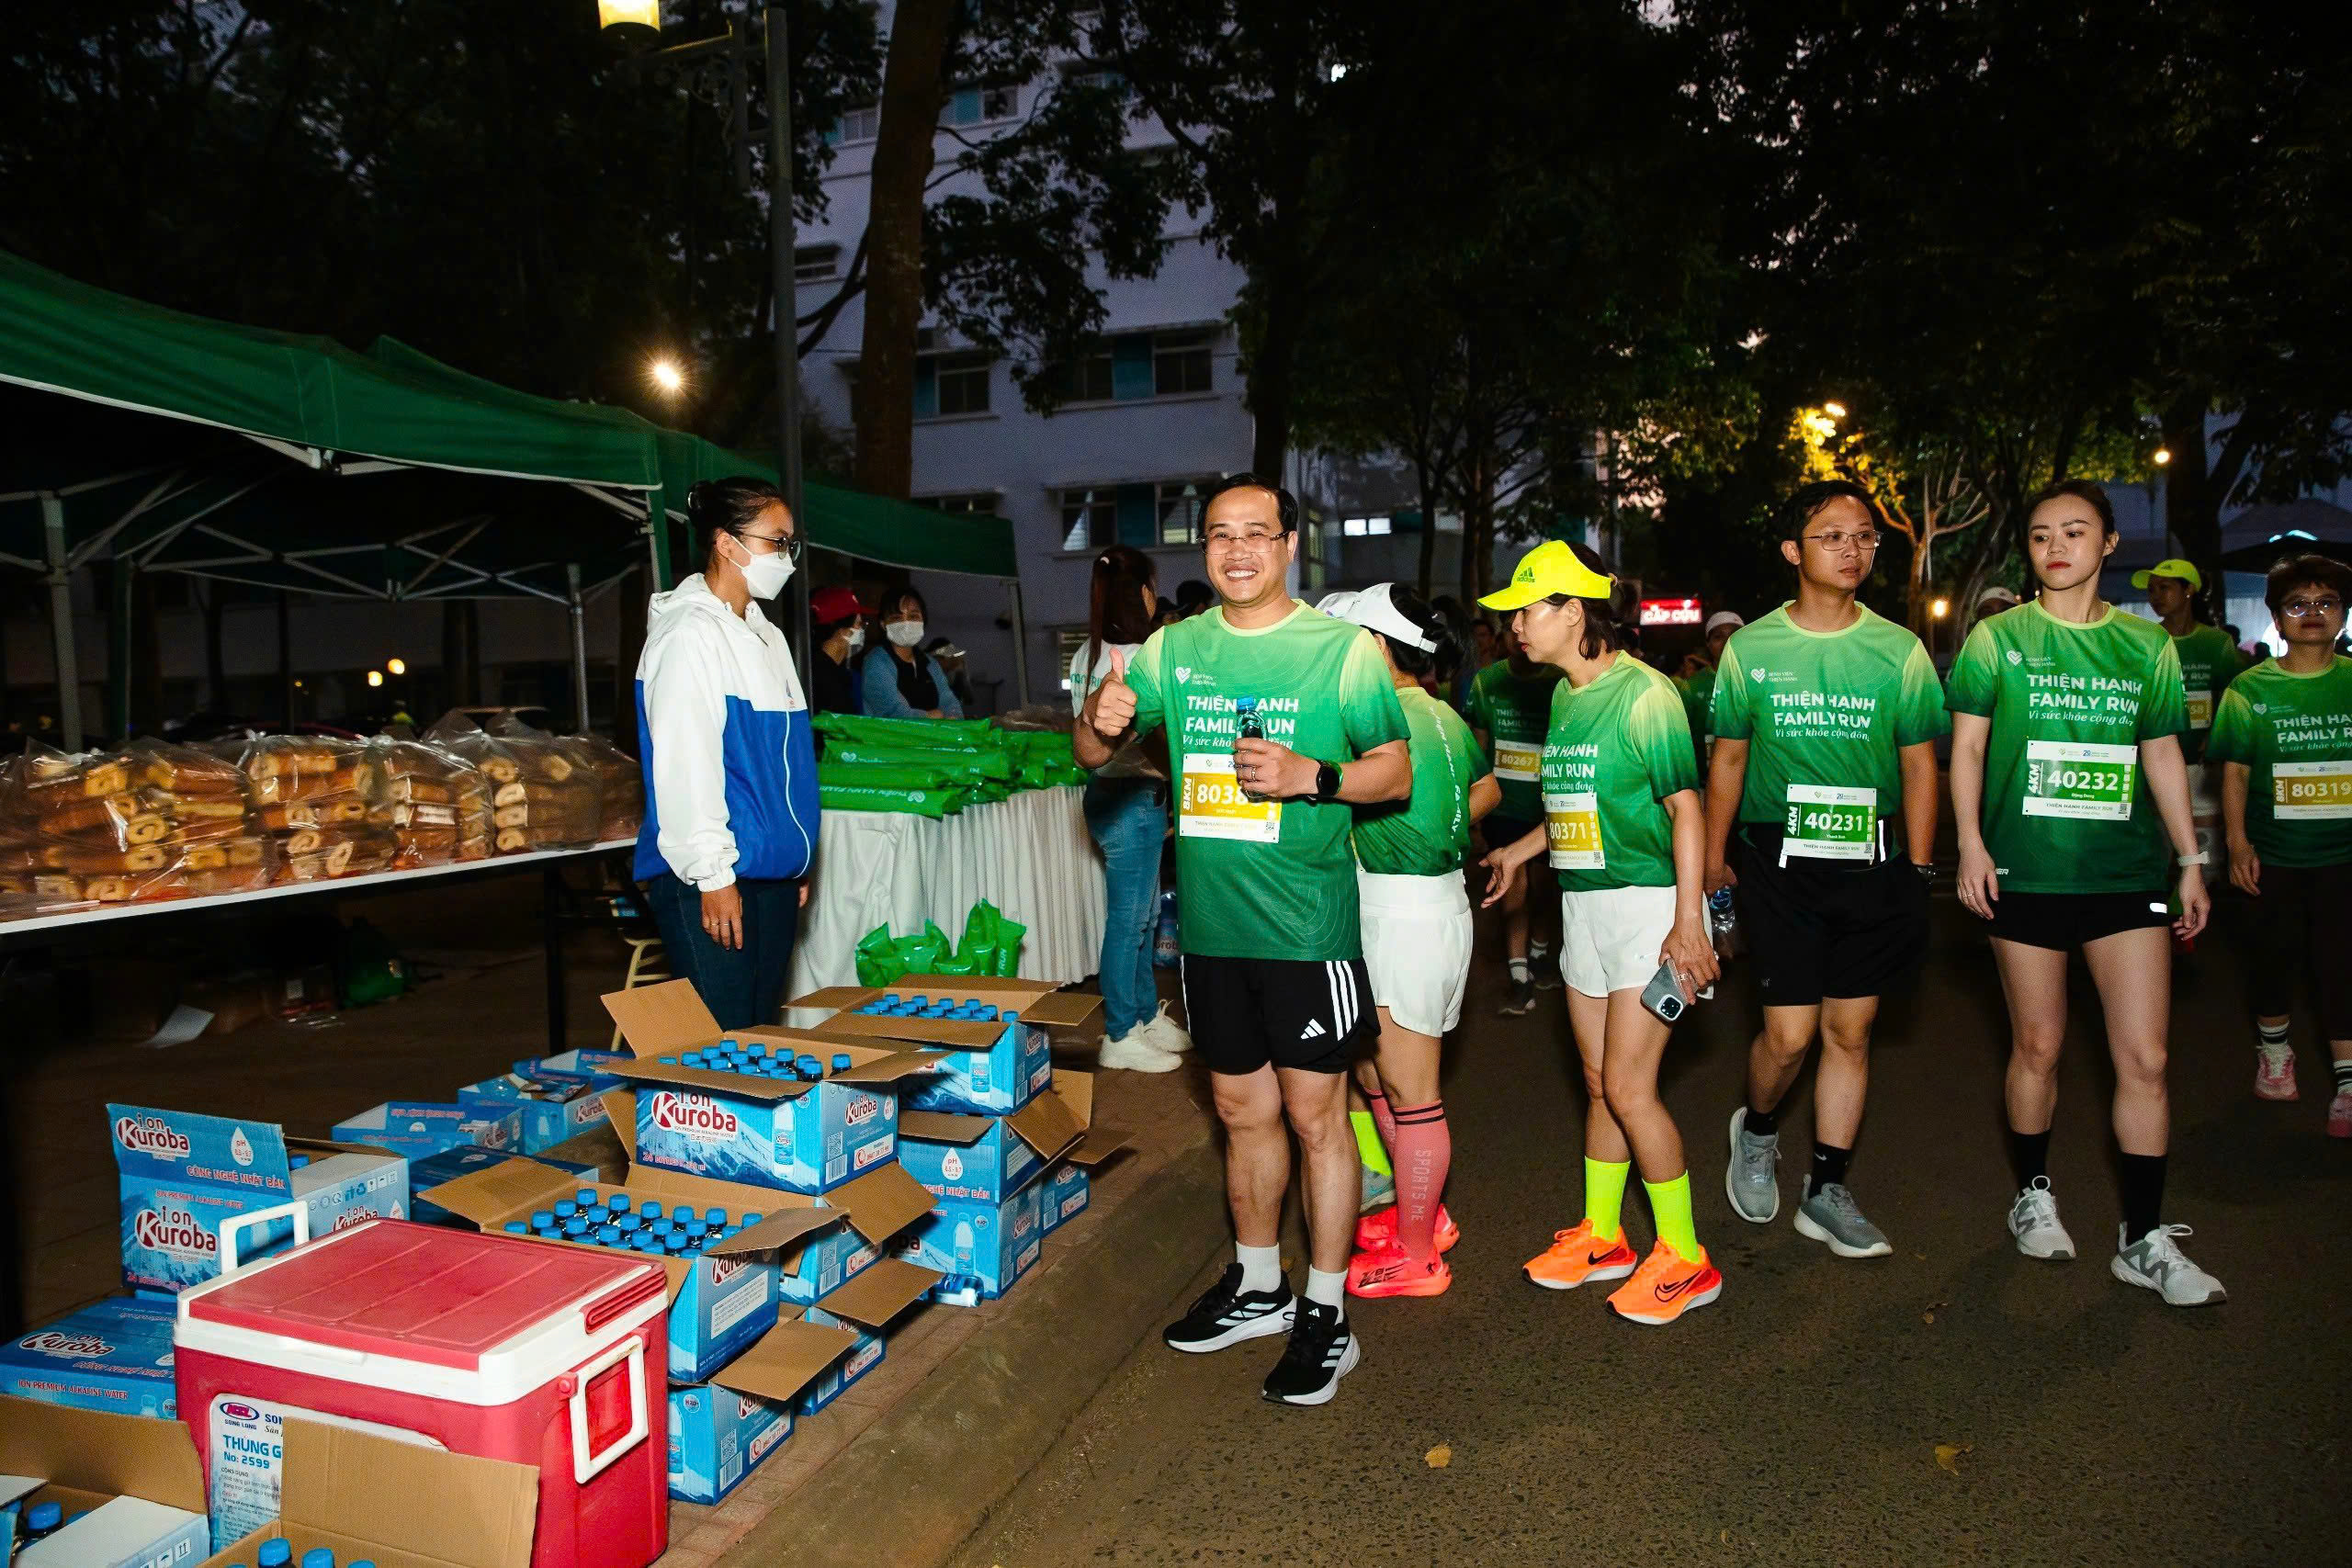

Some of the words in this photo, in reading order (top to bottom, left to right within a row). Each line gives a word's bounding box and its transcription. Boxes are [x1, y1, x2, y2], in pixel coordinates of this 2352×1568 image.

[2027, 672, 2086, 692] THIỆN
[2091, 677, 2143, 696] HẠNH
[1186, 694, 1238, 716] THIỆN
[1254, 697, 1299, 716] ẠNH
[1770, 690, 1825, 710] THIỆN
[1826, 694, 1876, 712] HẠNH
[2029, 692, 2101, 710] FAMILY
[2106, 696, 2140, 716] RUN
[1185, 716, 1237, 734] FAMIL
[1265, 716, 1295, 736] UN
[1773, 711, 1836, 727] FAMILY
[1838, 713, 1871, 728] RUN
[2029, 710, 2039, 720] Vì
[2041, 710, 2062, 720] sức
[2089, 714, 2117, 726] cộng
[2273, 714, 2323, 729] THIỆN
[2327, 714, 2352, 727] HẠ
[1182, 734, 1193, 746] Vì
[1194, 735, 1211, 747] sức
[1212, 735, 1232, 748] khỏ
[1775, 728, 1784, 738] Vì
[1786, 728, 1804, 738] sức
[1805, 728, 1829, 738] khỏe
[2277, 728, 2337, 744] FAMILY
[1560, 743, 1599, 761] HẠNH
[1541, 763, 1563, 778] MILY
[1566, 762, 1596, 779] RUN
[2028, 763, 2040, 794] 4KM
[2047, 770, 2118, 791] 40232
[1182, 777, 1193, 810] 8KM
[2291, 781, 2352, 798] 80319
[1549, 822, 1587, 840] 80371
[1787, 806, 1798, 836] 4KM
[1804, 812, 1862, 832] 40231
[651, 1091, 737, 1133] Kuroba
[845, 1099, 877, 1124] Kuroba
[118, 1117, 189, 1151] Kuroba
[947, 1157, 957, 1167] pH
[187, 1164, 213, 1179] CÔNG
[213, 1168, 241, 1185] NGHỆ
[1411, 1148, 1431, 1200] SPORTS
[945, 1185, 970, 1199] NHẬT
[971, 1186, 990, 1200] BẢN
[162, 1205, 192, 1226] ion
[137, 1210, 217, 1253] Kuroba
[21, 1333, 115, 1356] Kuroba
[18, 1379, 31, 1389] ION
[33, 1381, 67, 1393] PREMIUM
[69, 1386, 103, 1397] ALKALINE
[104, 1389, 129, 1401] WATER
[224, 1418, 241, 1427] SONG
[242, 1422, 257, 1430] LONG
[222, 1434, 269, 1457] THÙNG
[242, 1454, 270, 1470] 2599
